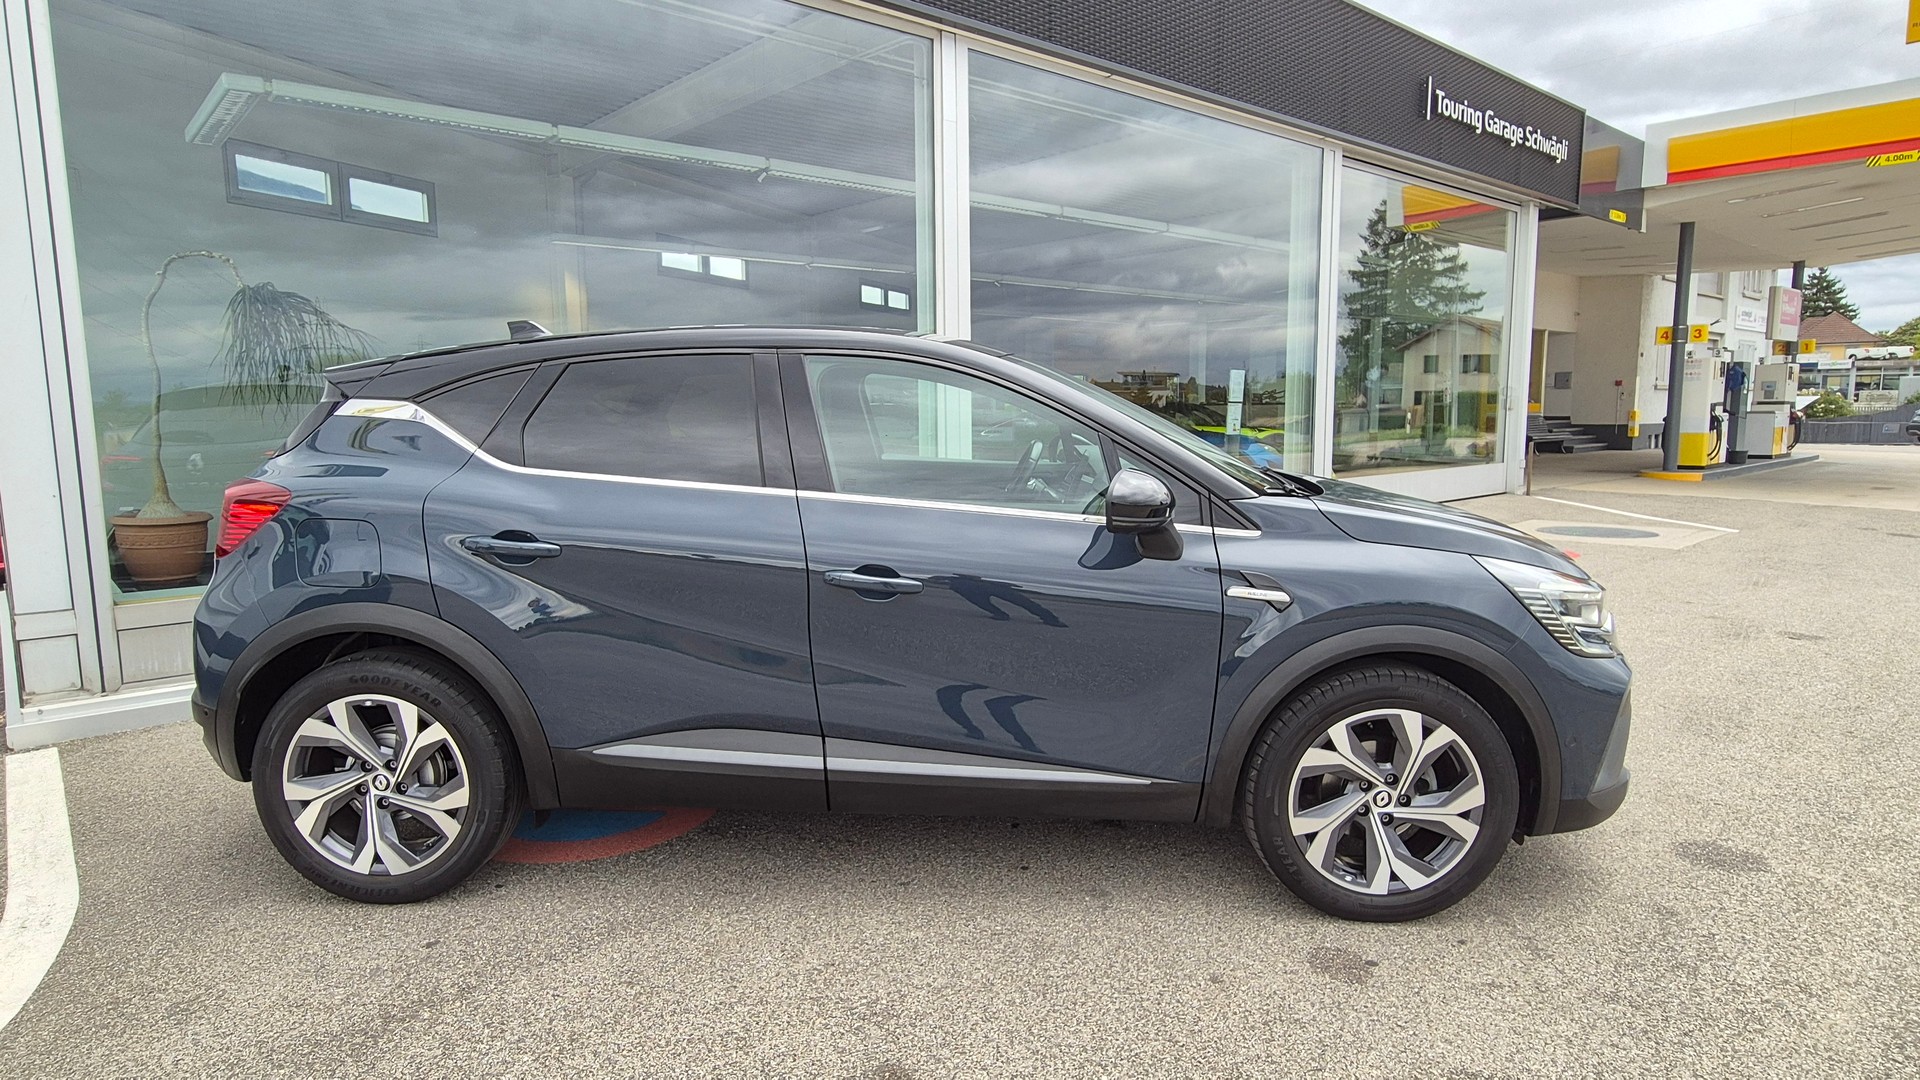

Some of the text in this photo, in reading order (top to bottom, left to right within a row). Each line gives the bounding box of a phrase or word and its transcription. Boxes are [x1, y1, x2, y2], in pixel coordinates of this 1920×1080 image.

[1435, 89, 1569, 164] Touring Garage Schwägli
[1660, 330, 1669, 341] 4
[1693, 328, 1703, 339] 3
[1777, 343, 1786, 353] 2
[1803, 342, 1809, 351] 1
